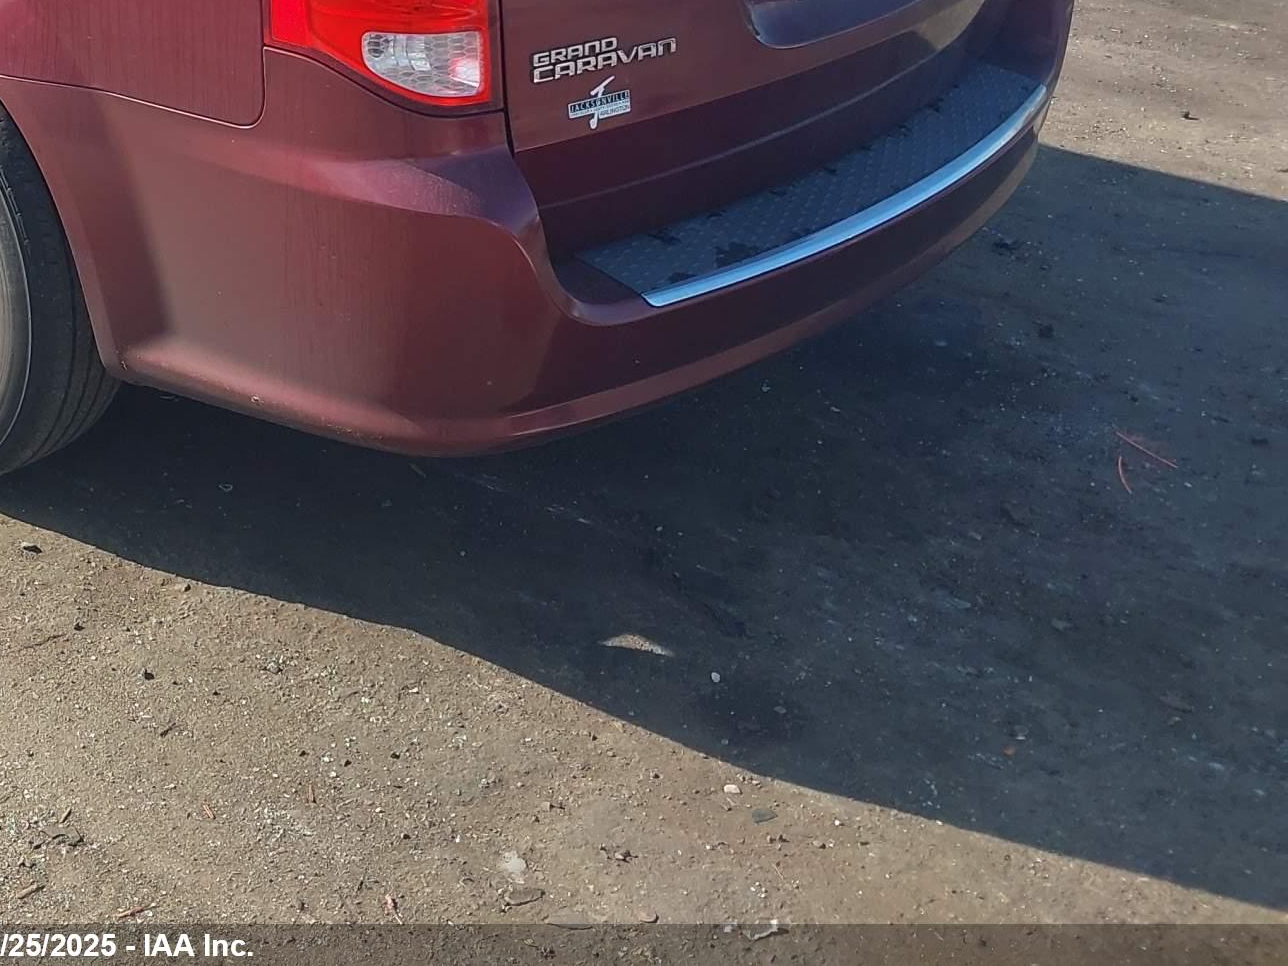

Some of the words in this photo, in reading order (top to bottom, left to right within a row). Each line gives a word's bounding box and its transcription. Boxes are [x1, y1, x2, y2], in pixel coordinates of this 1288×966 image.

[532, 37, 618, 68] GRAND
[532, 37, 677, 84] CARAVAN
[570, 90, 630, 113] JACKSONVILLE
